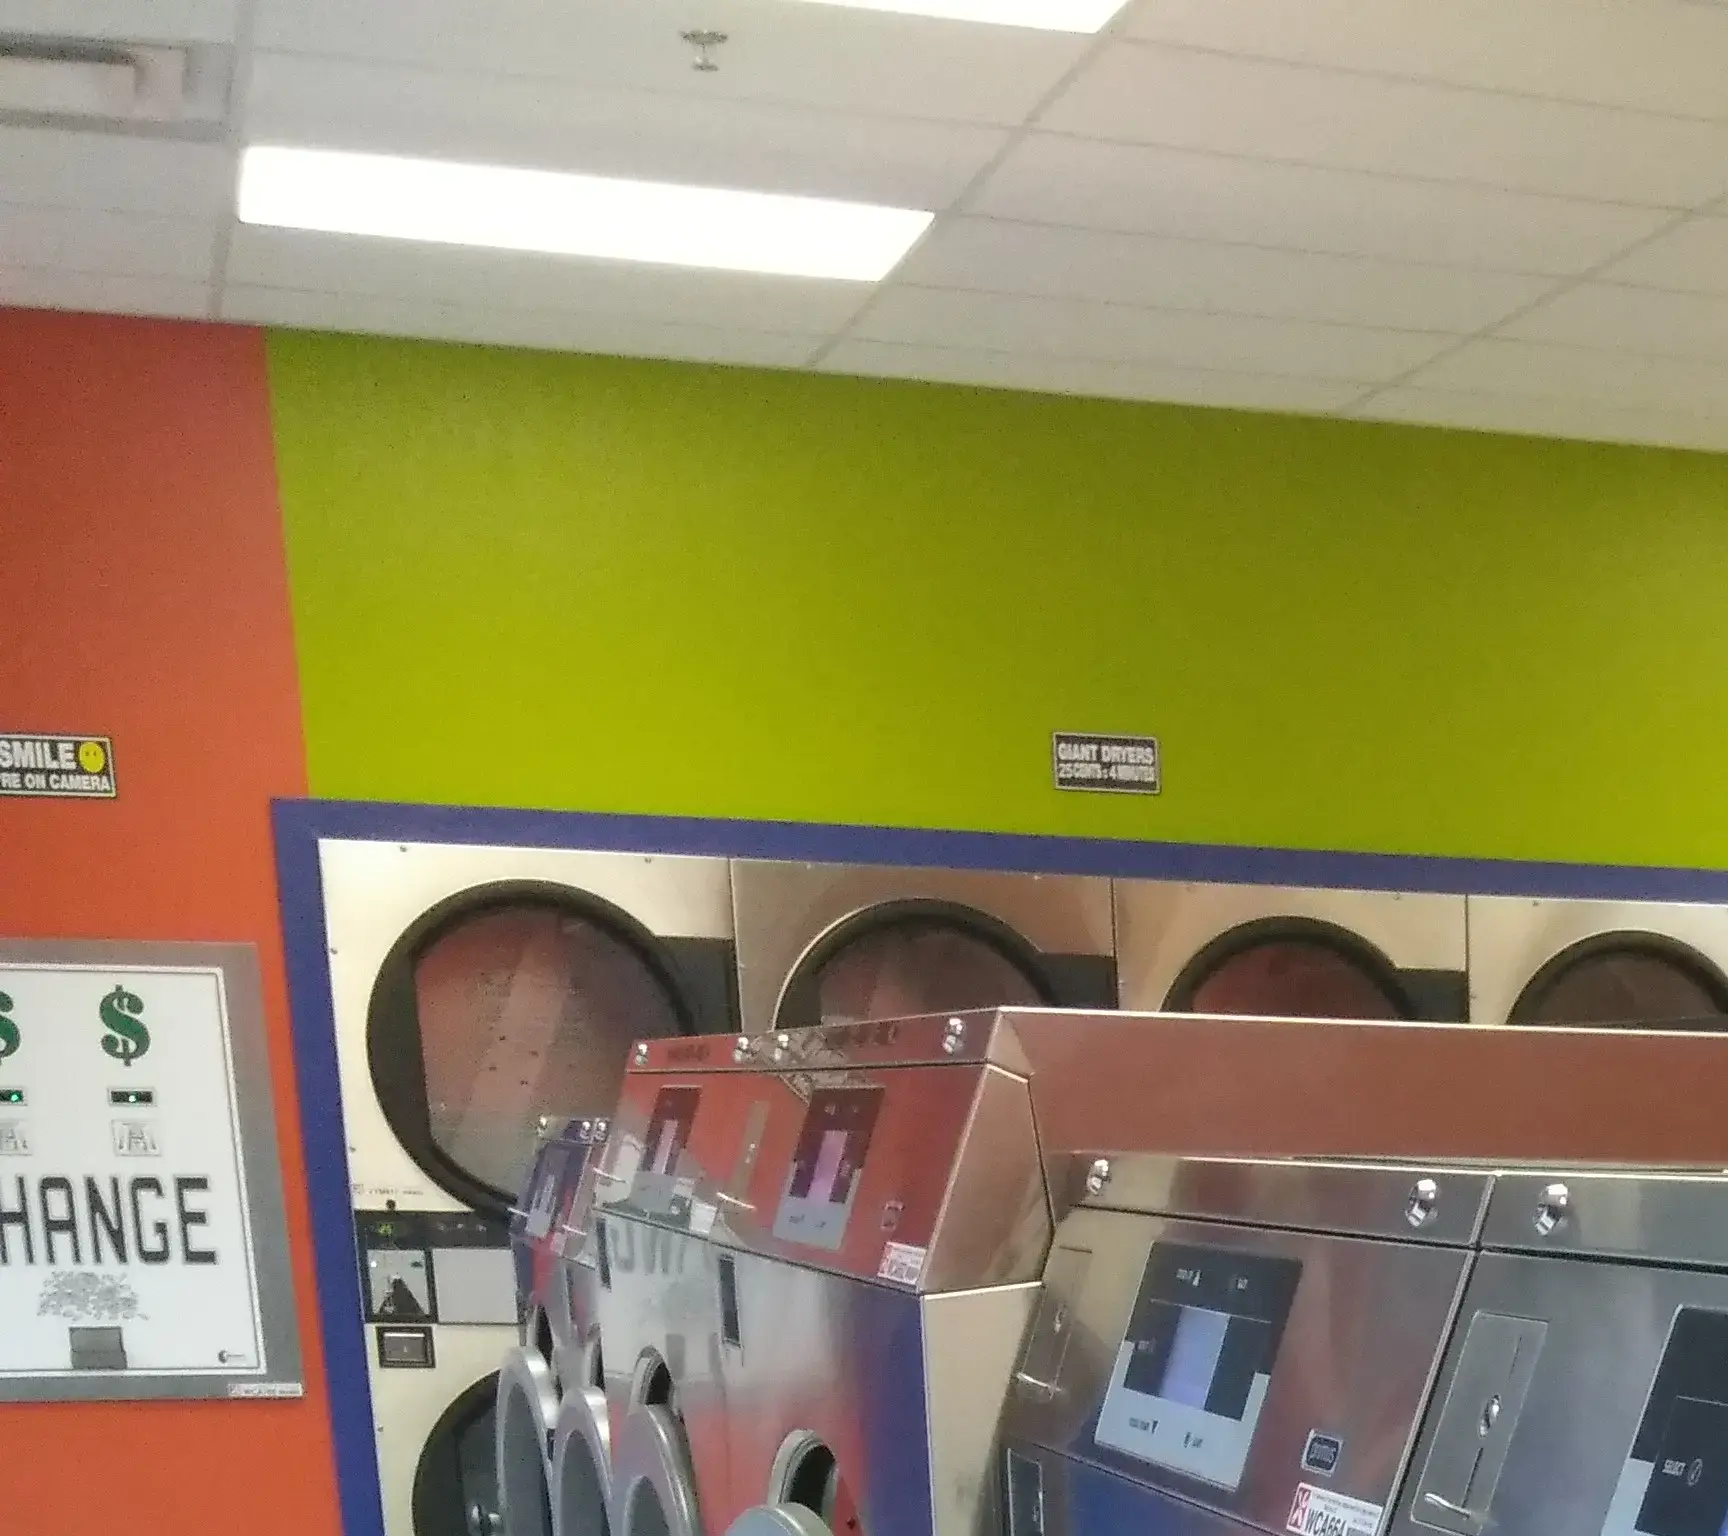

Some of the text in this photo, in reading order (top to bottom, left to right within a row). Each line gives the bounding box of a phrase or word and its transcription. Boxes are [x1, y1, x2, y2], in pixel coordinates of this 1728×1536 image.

[0, 740, 76, 769] SMILE
[1058, 743, 1154, 765] GIANT DRYERS
[24, 773, 46, 789] ON
[49, 774, 111, 791] CAMERA
